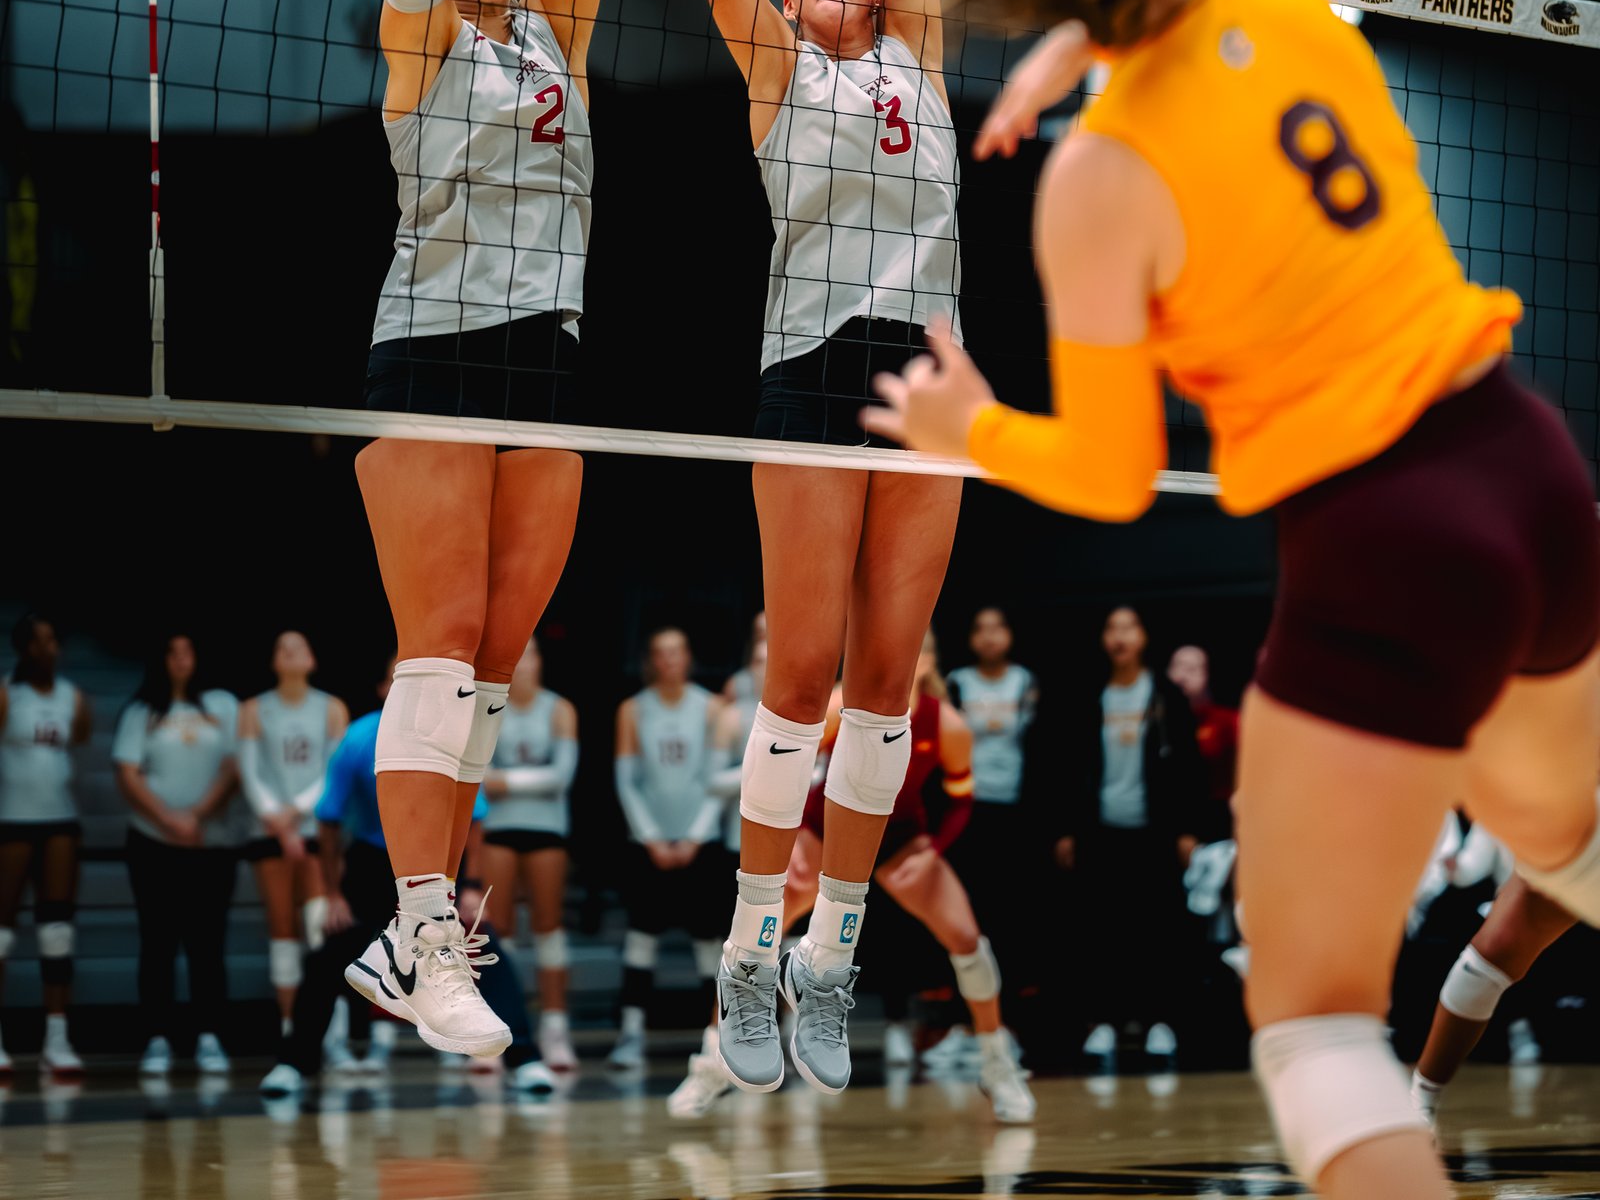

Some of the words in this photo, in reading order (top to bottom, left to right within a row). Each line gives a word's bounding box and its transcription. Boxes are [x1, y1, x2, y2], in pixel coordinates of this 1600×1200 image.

[1540, 16, 1580, 36] MILWAUKEE
[531, 83, 565, 145] 2
[872, 94, 912, 155] 3
[1279, 100, 1382, 232] 8
